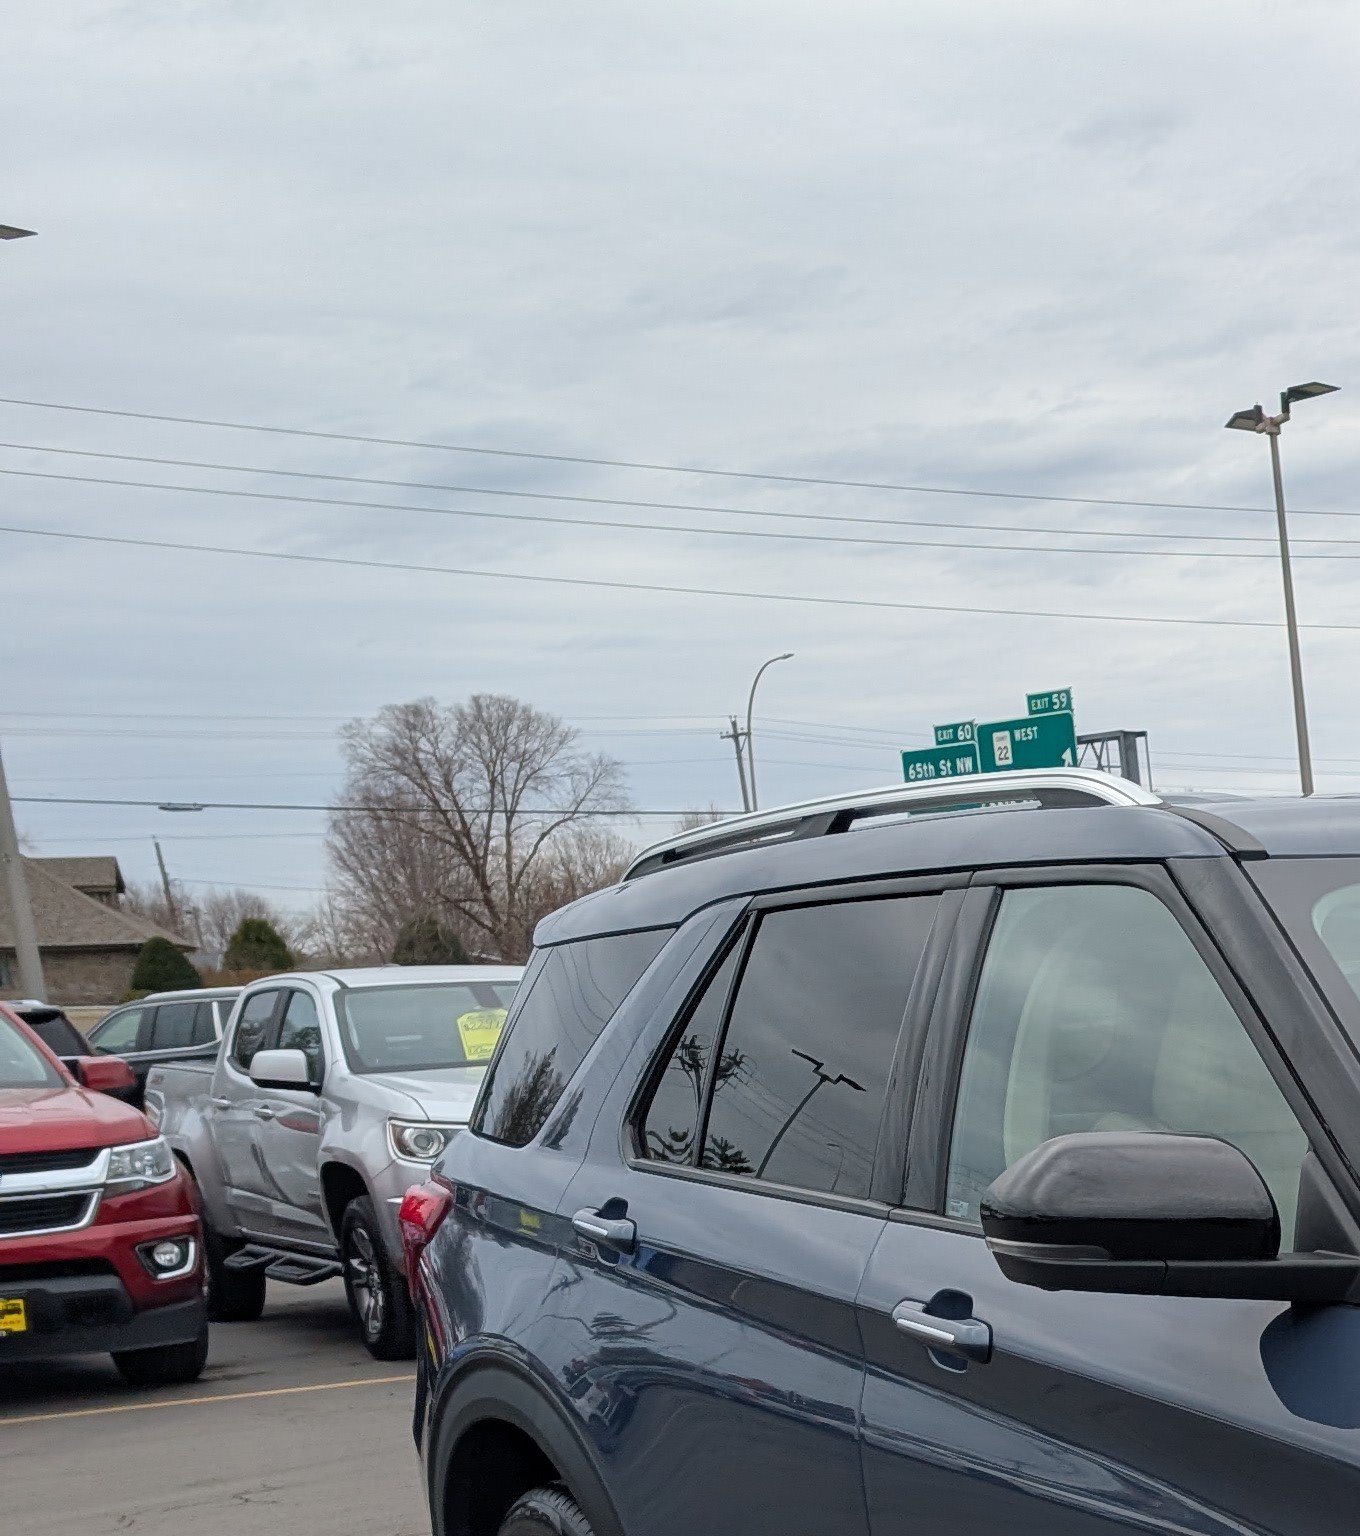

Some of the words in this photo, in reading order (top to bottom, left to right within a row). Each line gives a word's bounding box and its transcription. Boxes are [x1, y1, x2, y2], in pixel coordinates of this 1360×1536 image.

[1031, 696, 1049, 711] EXIT
[1051, 692, 1067, 710] 59
[937, 728, 953, 741] EXIT
[957, 724, 972, 741] 60
[1013, 726, 1038, 742] WEST
[997, 745, 1010, 762] 22
[908, 762, 936, 780] 65th
[939, 760, 953, 775] St
[956, 756, 973, 774] NW
